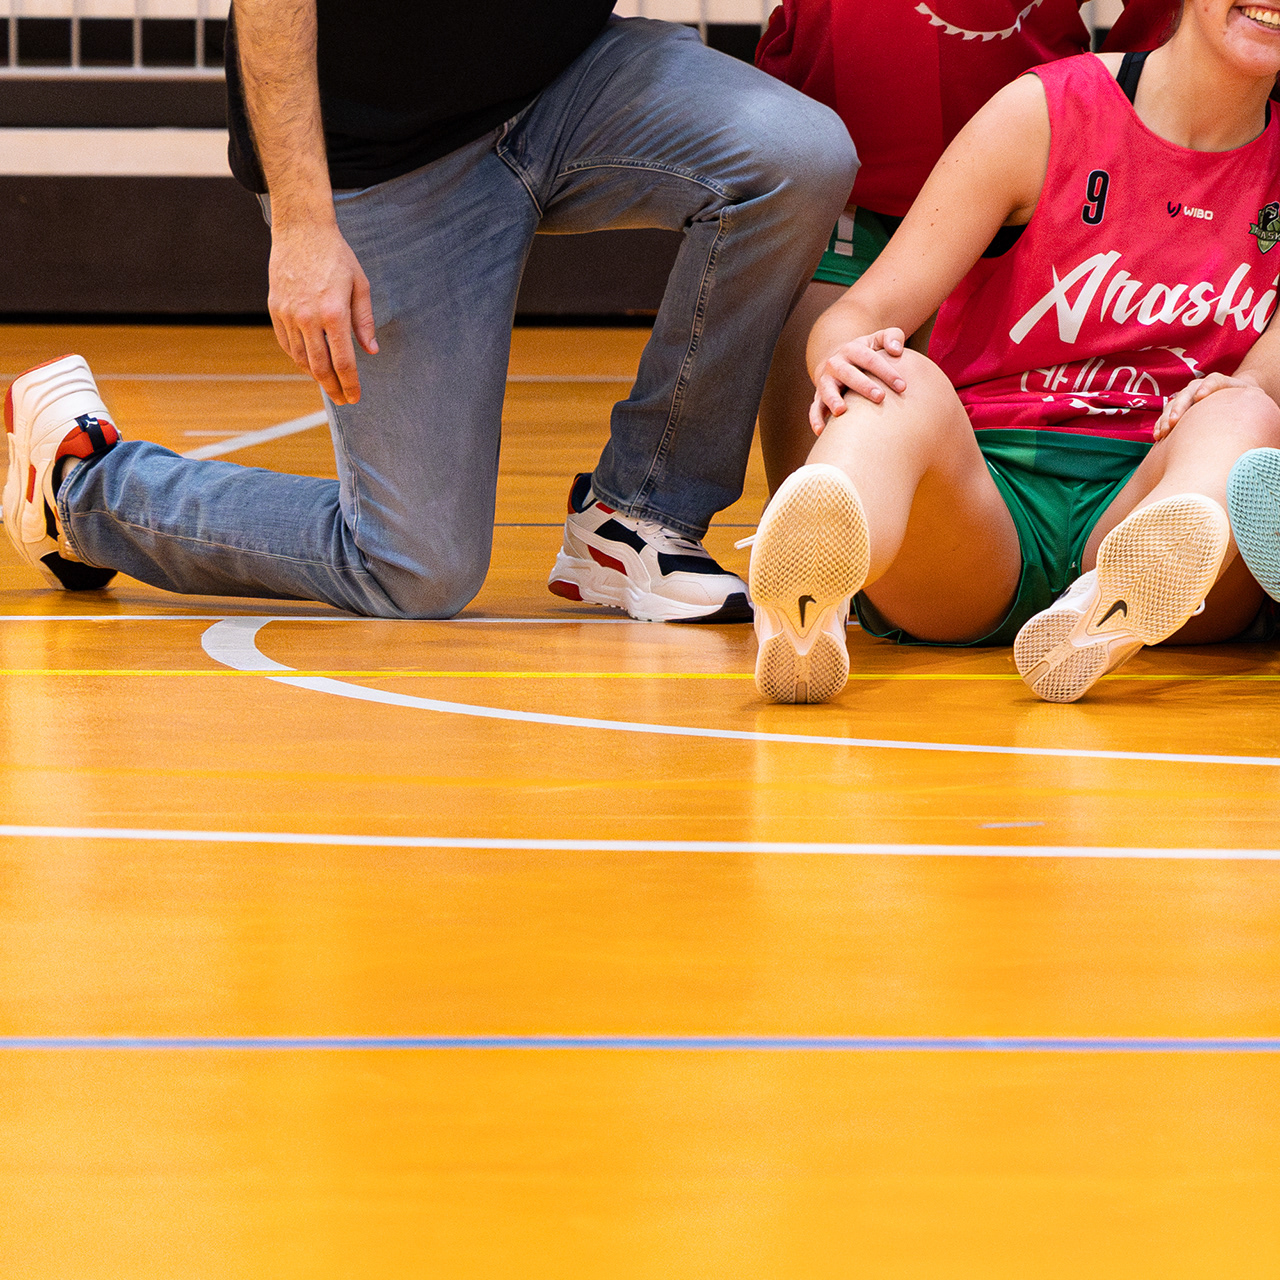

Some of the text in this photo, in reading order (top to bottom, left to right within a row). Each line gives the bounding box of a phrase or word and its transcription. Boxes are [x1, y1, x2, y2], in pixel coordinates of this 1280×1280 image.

[1082, 169, 1110, 226] 9
[1183, 206, 1214, 221] WIBO
[1009, 250, 1280, 345] Araski
